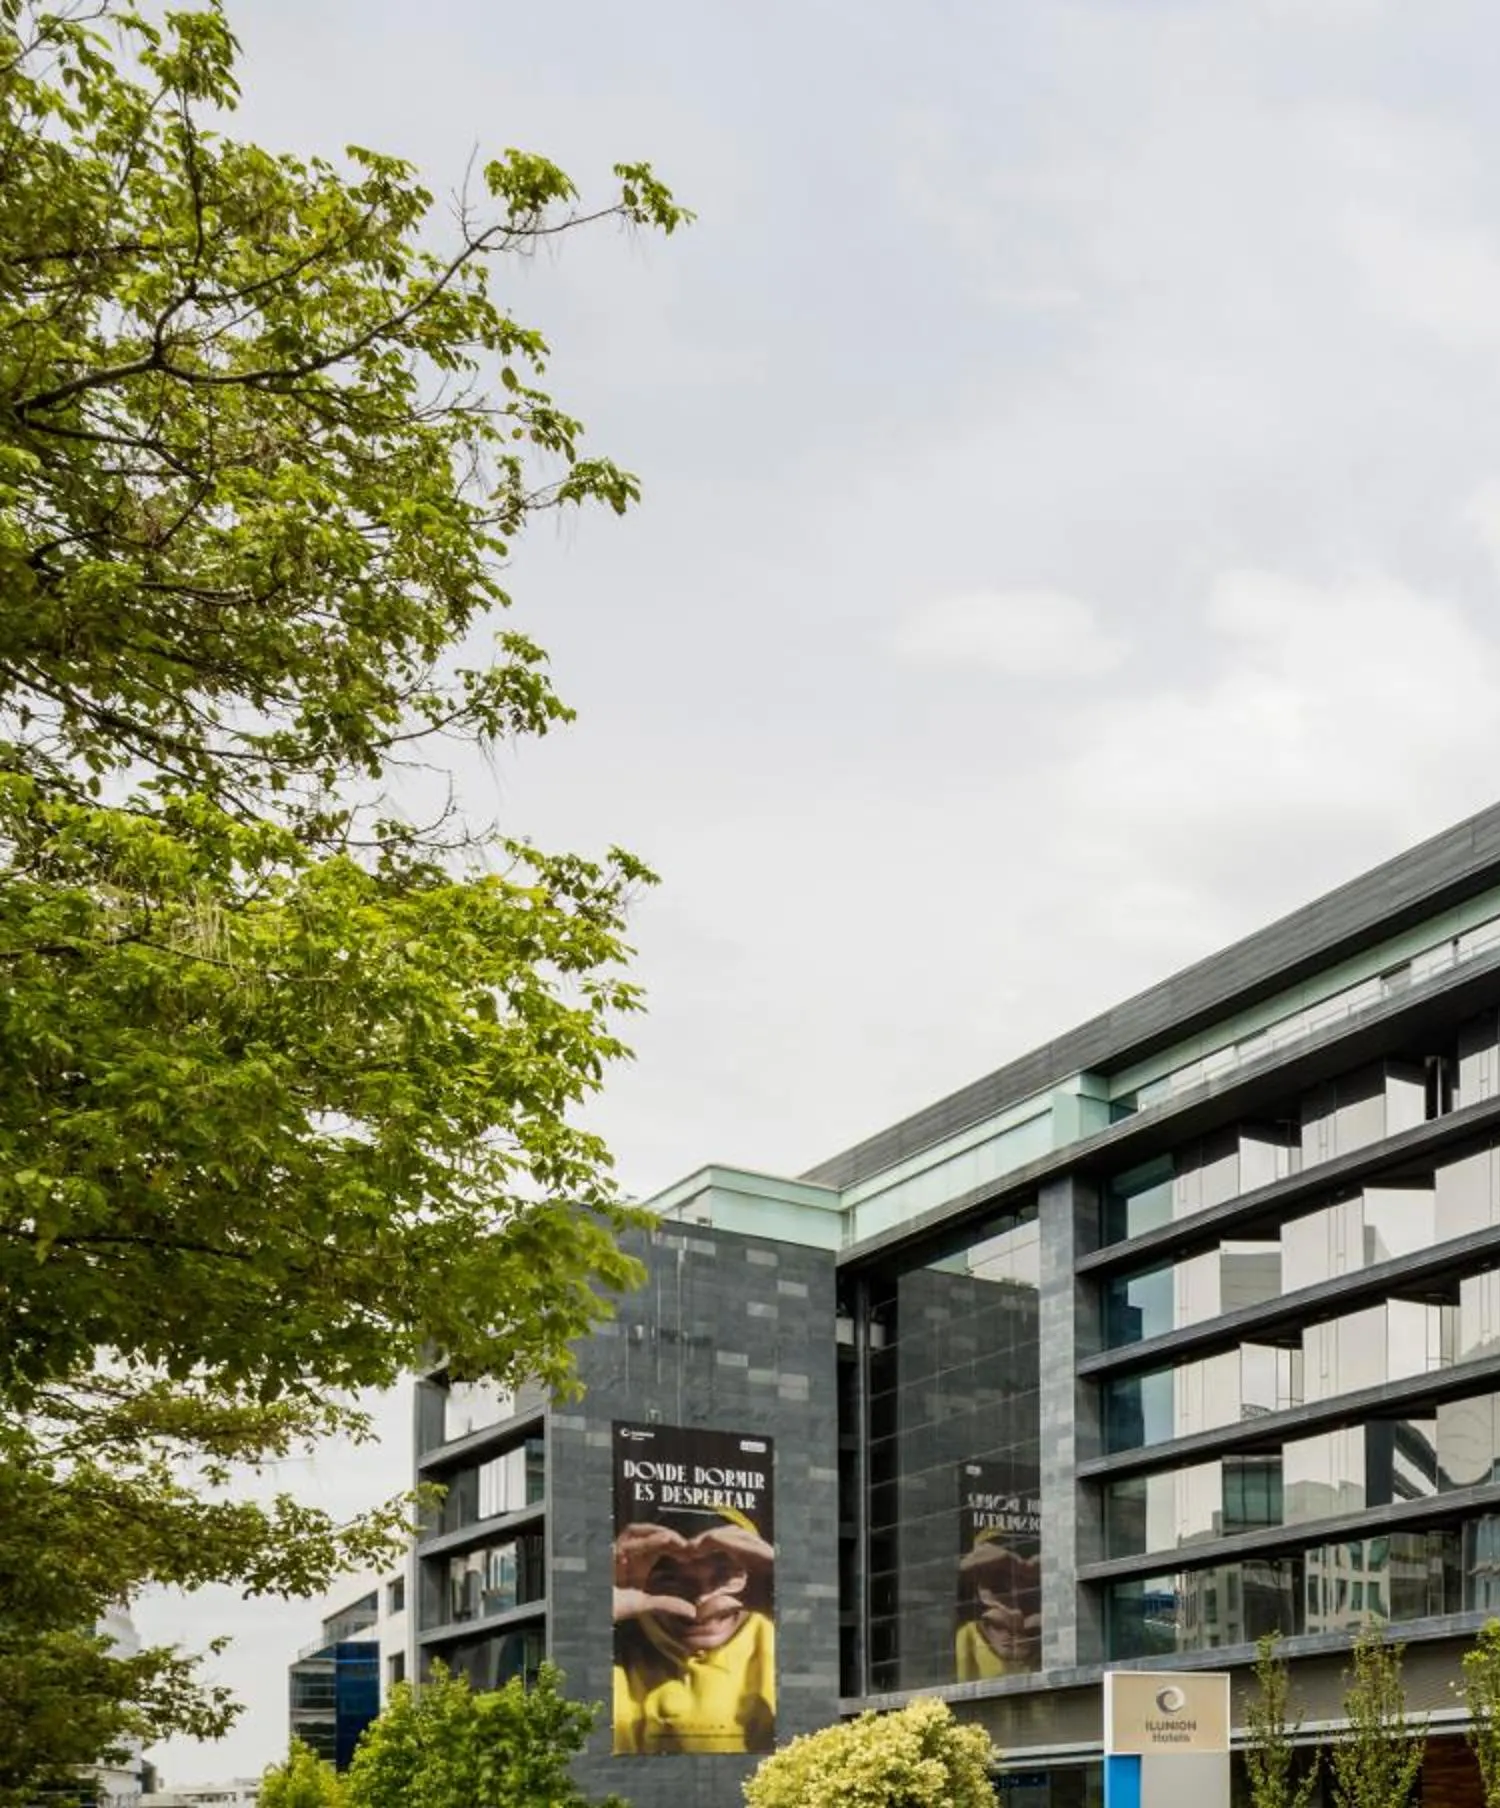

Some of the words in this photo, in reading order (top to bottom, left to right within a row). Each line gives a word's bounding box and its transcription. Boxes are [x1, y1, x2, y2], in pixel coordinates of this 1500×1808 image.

[623, 1460, 686, 1482] DONDE
[695, 1466, 765, 1489] DORMIR
[634, 1482, 655, 1502] ES
[661, 1484, 757, 1510] DESPERTAR
[1146, 1720, 1197, 1731] ILUNION
